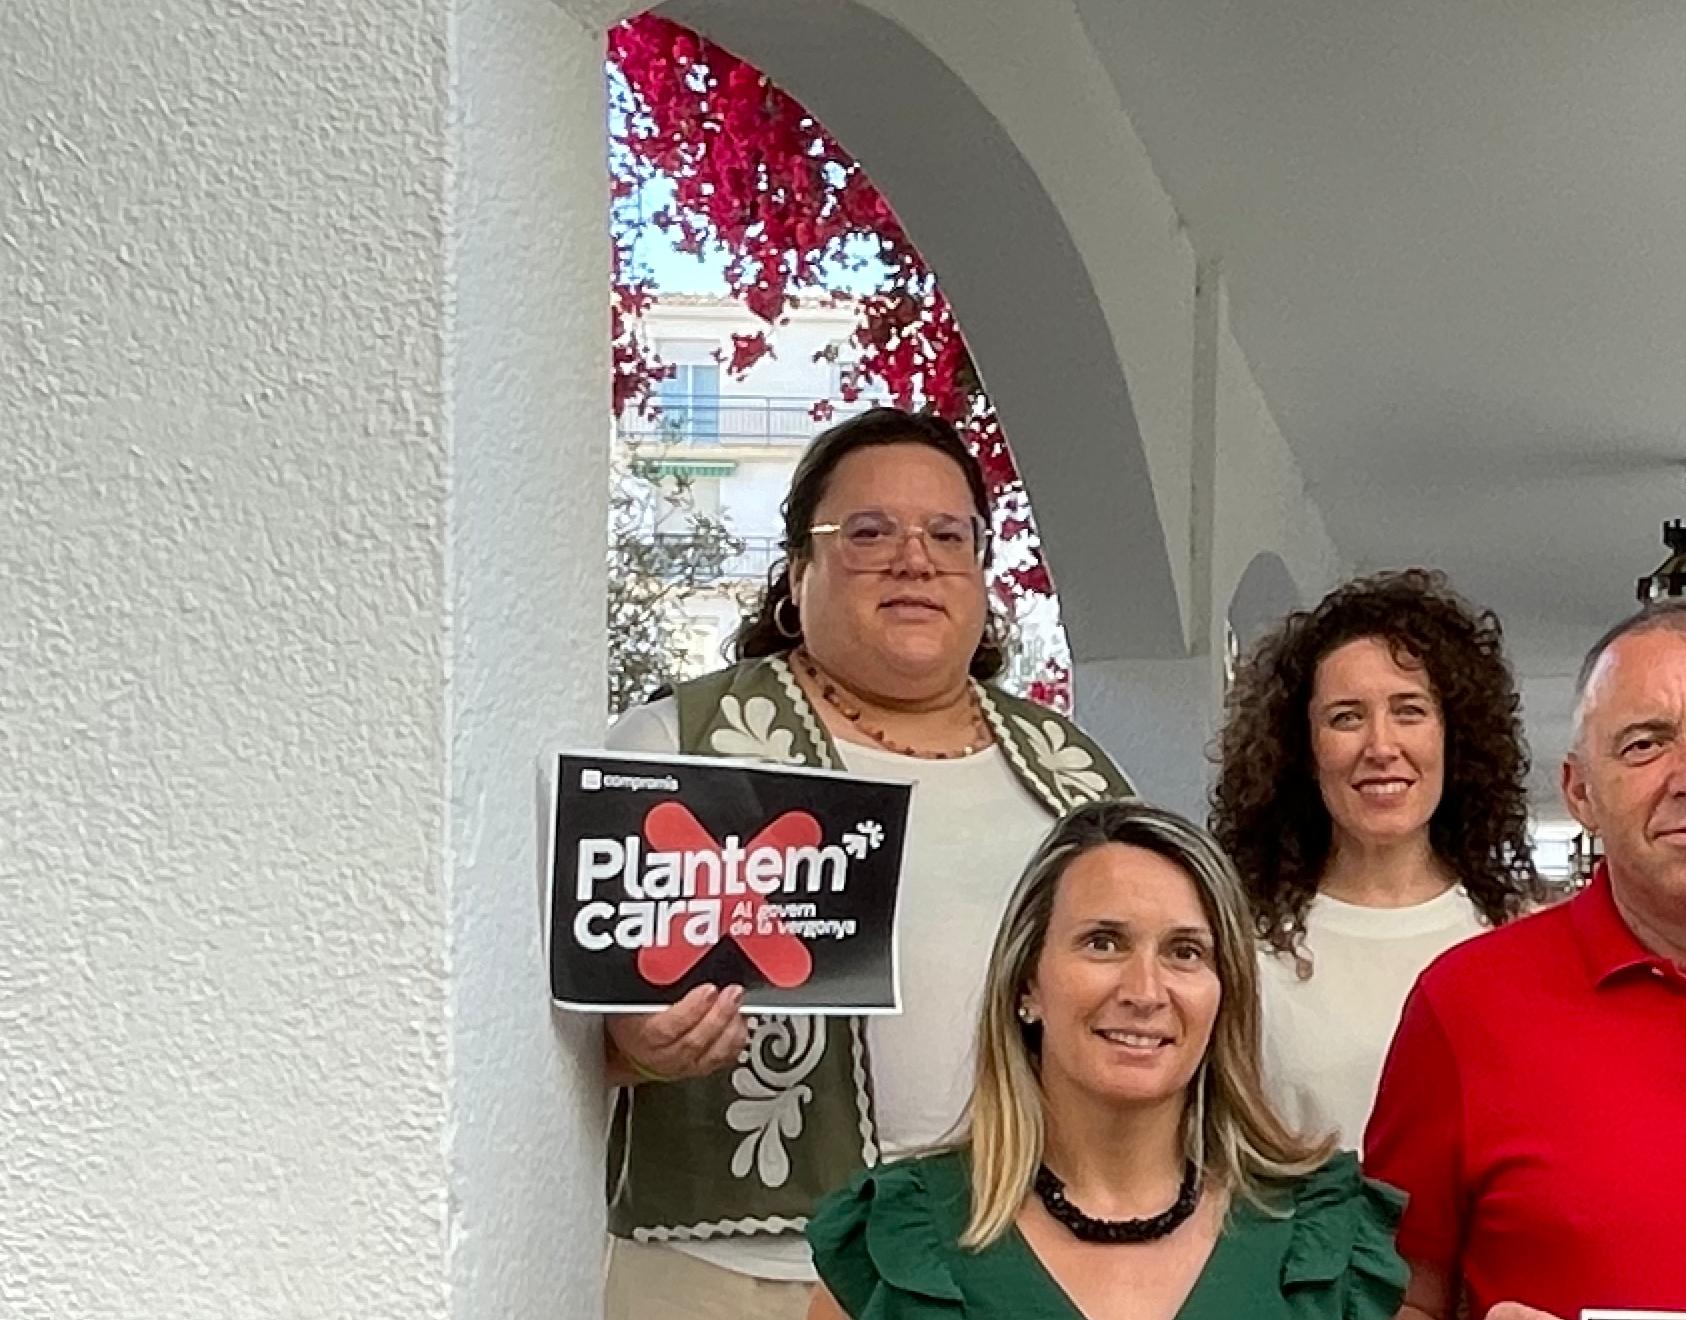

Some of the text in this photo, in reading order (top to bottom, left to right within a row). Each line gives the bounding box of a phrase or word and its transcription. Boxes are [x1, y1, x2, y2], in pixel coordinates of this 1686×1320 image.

[576, 835, 847, 900] Plantem
[574, 899, 721, 950] cara
[731, 901, 751, 918] Al
